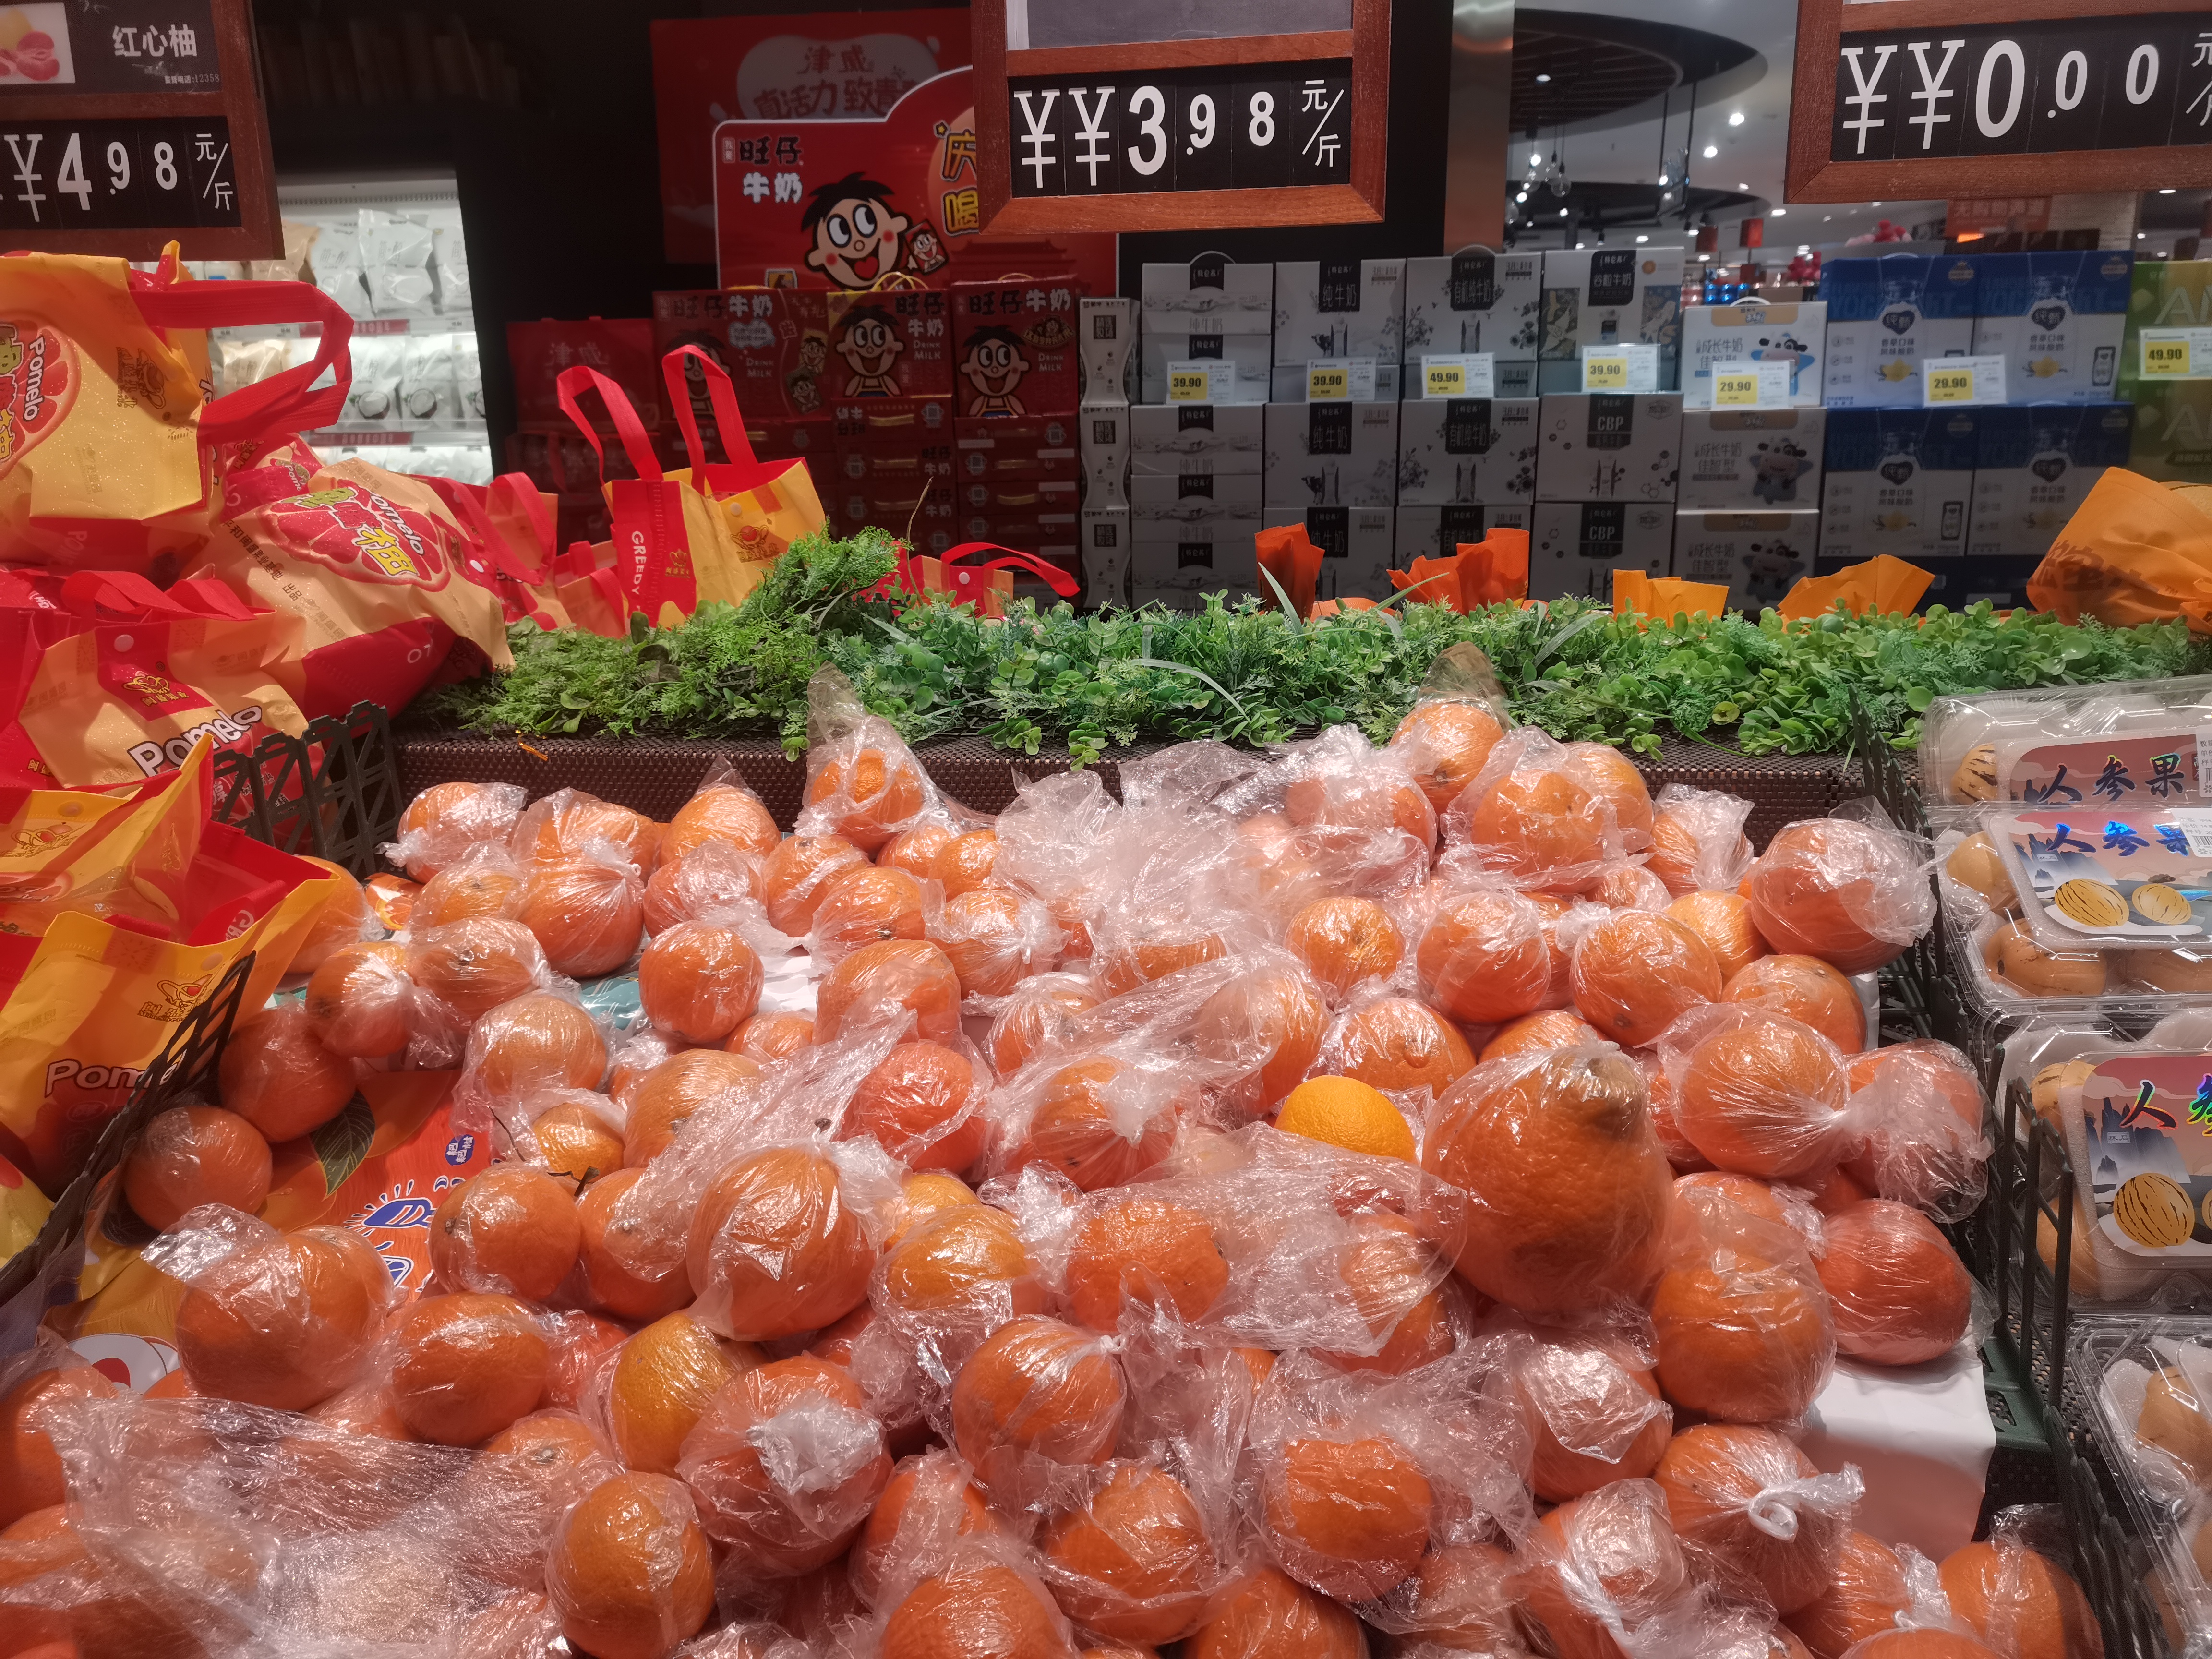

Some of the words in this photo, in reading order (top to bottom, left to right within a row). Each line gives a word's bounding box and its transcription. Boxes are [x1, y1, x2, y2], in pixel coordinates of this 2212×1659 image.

[112, 24, 198, 58] 红心柚
[739, 136, 801, 165] 旺仔
[743, 172, 803, 204] 牛奶
[1322, 283, 1357, 308] 纯牛奶
[908, 319, 944, 337] 牛奶
[914, 351, 941, 360] MILK
[2148, 348, 2182, 360] 49.90
[24, 336, 46, 421] Pomelo
[1430, 372, 1459, 383] 49.90
[1590, 365, 1621, 375] 39.90
[1173, 377, 1202, 388] 39.90
[1313, 375, 1342, 386] 39.90
[1720, 381, 1751, 392] 29.90
[1934, 377, 1968, 389] 29.90
[1597, 415, 1624, 431] CBP
[1313, 425, 1348, 450] 纯牛奶
[370, 492, 425, 555] omelo
[1588, 526, 1616, 541] CBP
[632, 530, 647, 595] GREEDY
[282, 583, 302, 601] 出品
[2037, 753, 2185, 804] 人参果
[2046, 821, 2191, 857] 人参果
